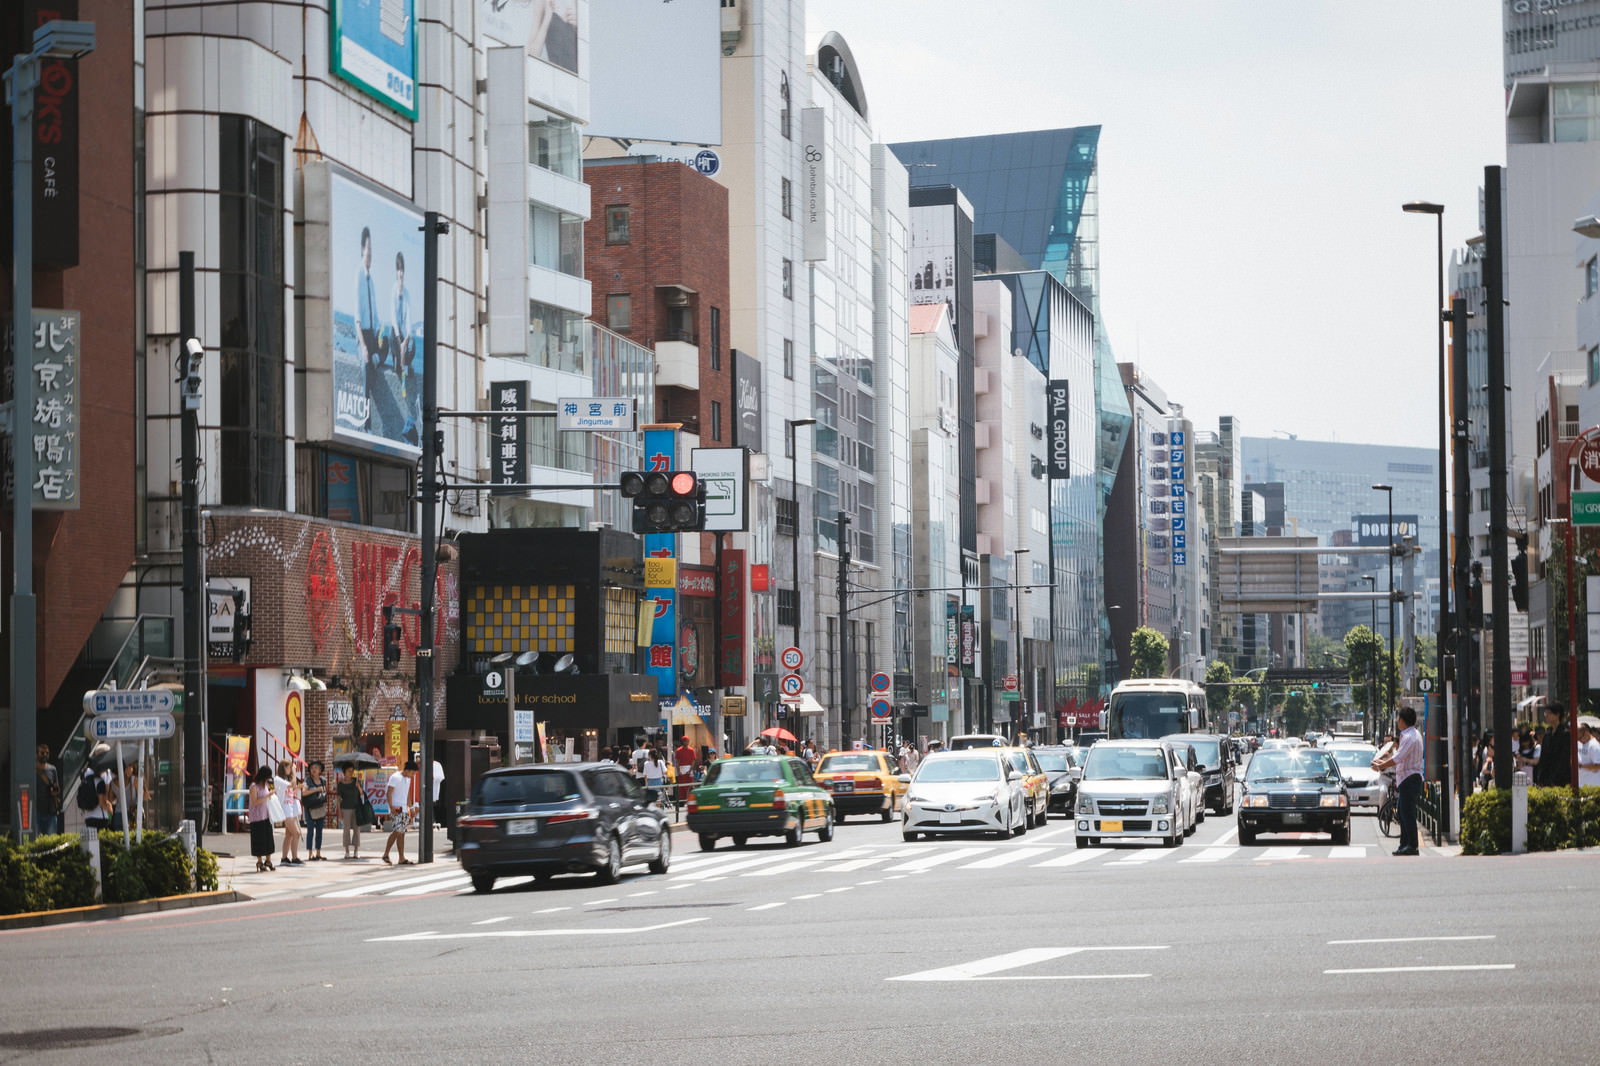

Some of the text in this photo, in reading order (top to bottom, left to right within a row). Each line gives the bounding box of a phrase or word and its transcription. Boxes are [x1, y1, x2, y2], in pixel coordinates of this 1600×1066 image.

[60, 317, 75, 330] 3F
[33, 321, 65, 500] 北京烤鴨店
[337, 390, 370, 419] MATCH
[564, 403, 627, 417] 神宮前
[577, 417, 613, 426] Jingumae
[1053, 389, 1067, 470] PAL GROUP
[1584, 450, 1600, 470] 消
[1172, 453, 1185, 564] ダイヤモンド社
[1361, 521, 1417, 537] DOUTOR
[649, 452, 672, 668] カケ館
[785, 653, 799, 664] 50
[496, 693, 520, 703] col
[524, 693, 540, 703] for
[542, 693, 577, 704] school
[391, 723, 401, 756] MEN'S
